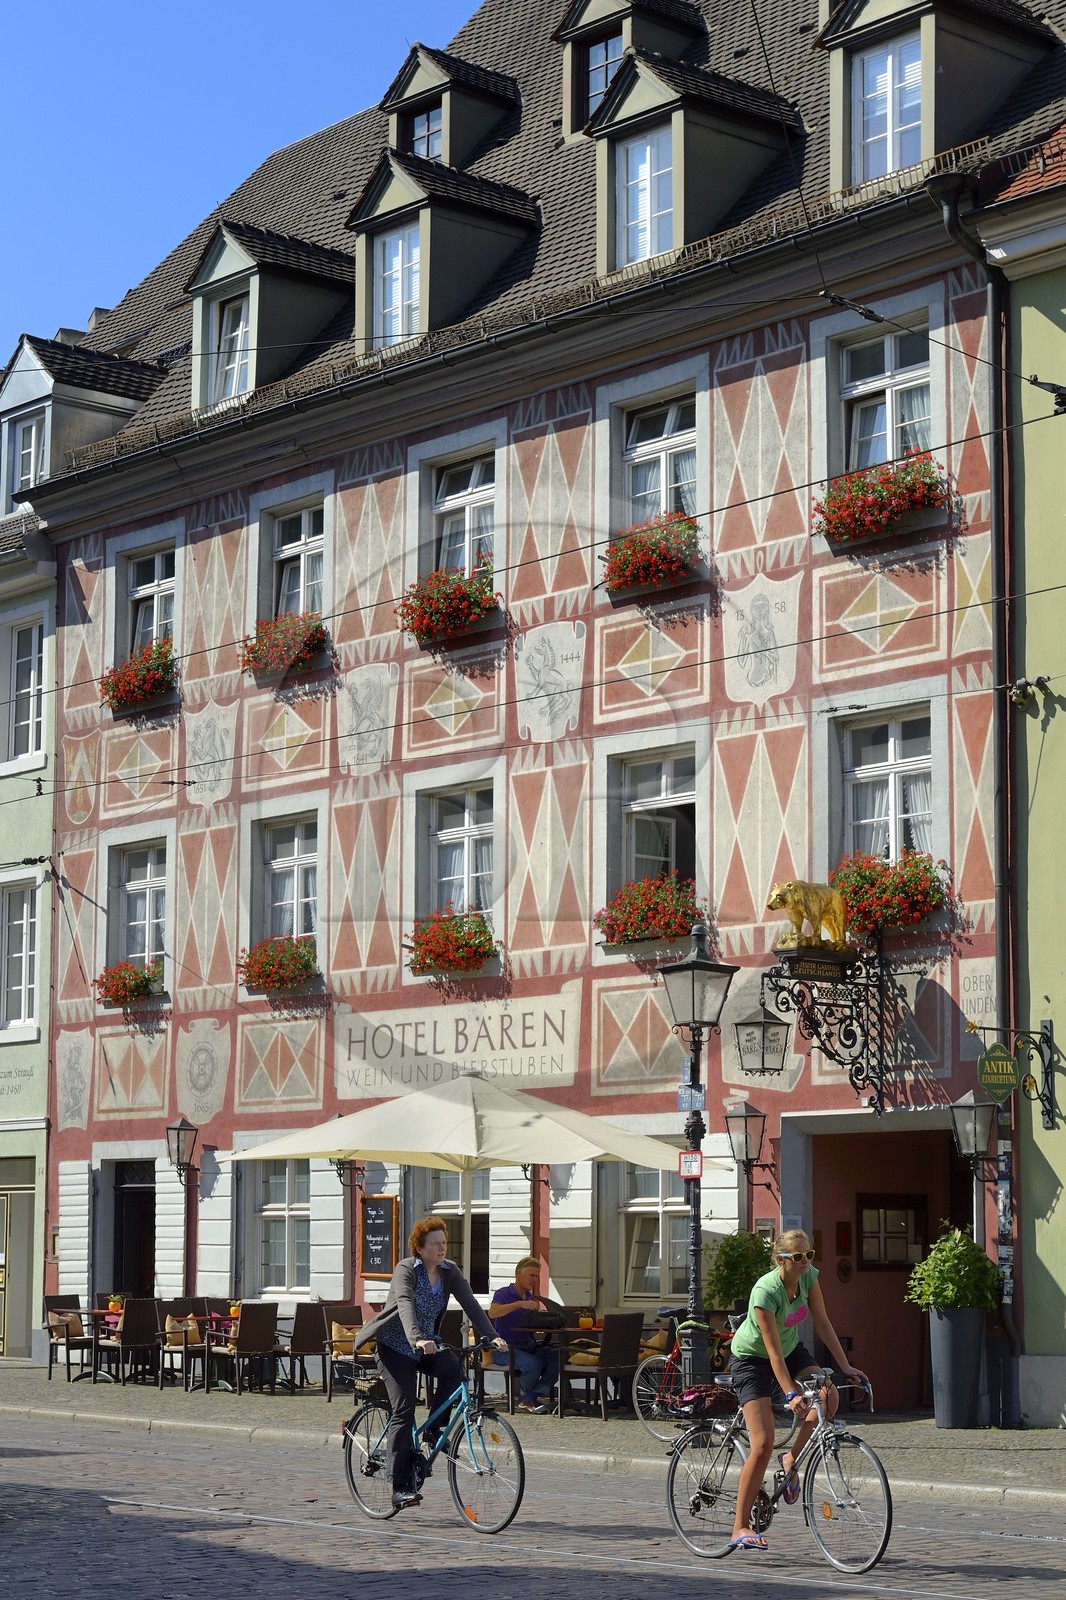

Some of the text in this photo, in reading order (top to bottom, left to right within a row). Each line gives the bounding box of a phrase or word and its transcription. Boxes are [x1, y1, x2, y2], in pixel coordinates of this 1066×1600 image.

[774, 600, 786, 614] 58
[561, 651, 581, 664] 1444
[963, 974, 994, 992] OBER-
[347, 1009, 566, 1061] HOTEL BÄREN
[452, 1054, 564, 1080] BIERSTUBEN
[984, 1061, 1014, 1074] ANTIK
[981, 1074, 1017, 1084] EINRICHTUNG
[7, 1084, 21, 1095] 1460
